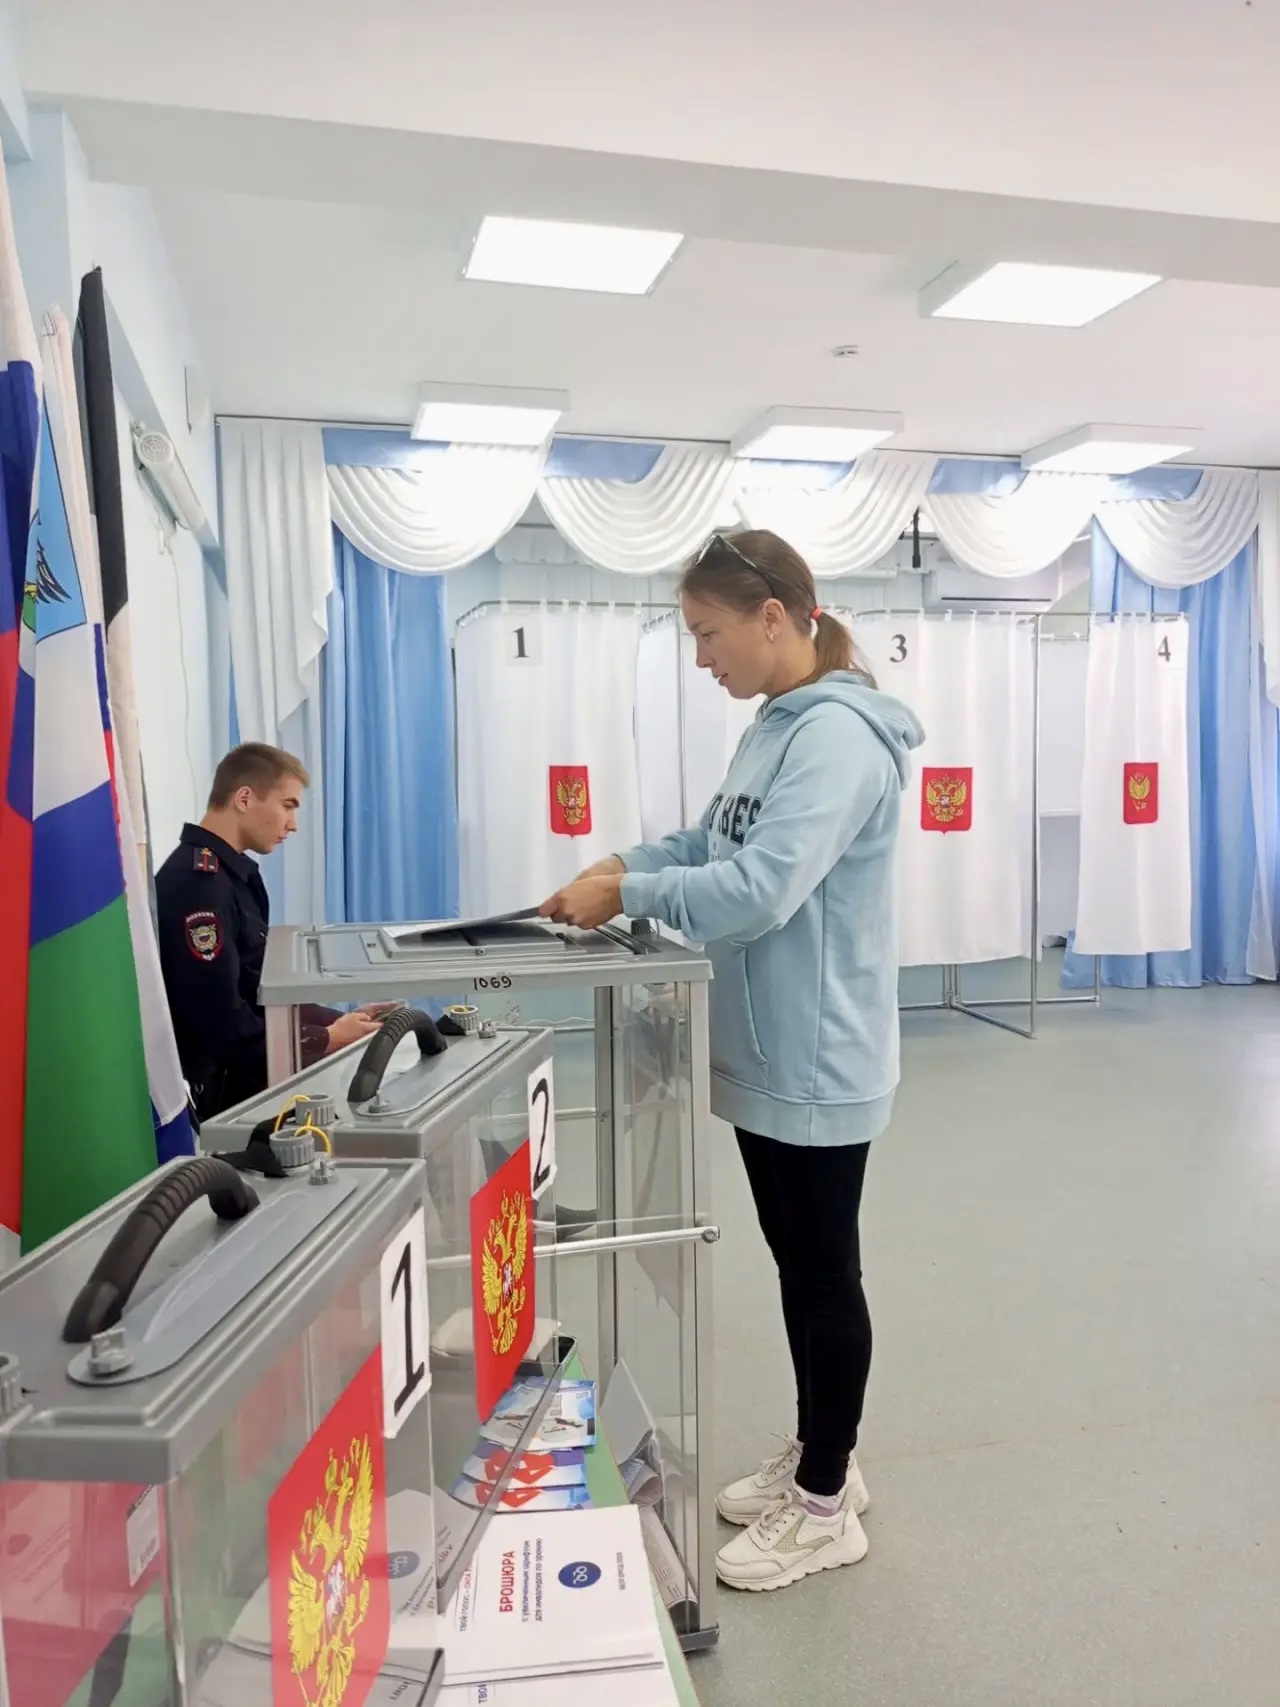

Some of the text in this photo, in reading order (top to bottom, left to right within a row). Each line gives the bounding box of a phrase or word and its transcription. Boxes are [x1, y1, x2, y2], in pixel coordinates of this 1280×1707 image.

[511, 626, 530, 658] 1
[889, 633, 907, 663] 3
[1158, 635, 1171, 662] 4
[473, 975, 512, 991] 1069
[531, 1078, 551, 1192] 2
[391, 1241, 425, 1416] 1
[499, 1550, 515, 1613] БРОШЮРА
